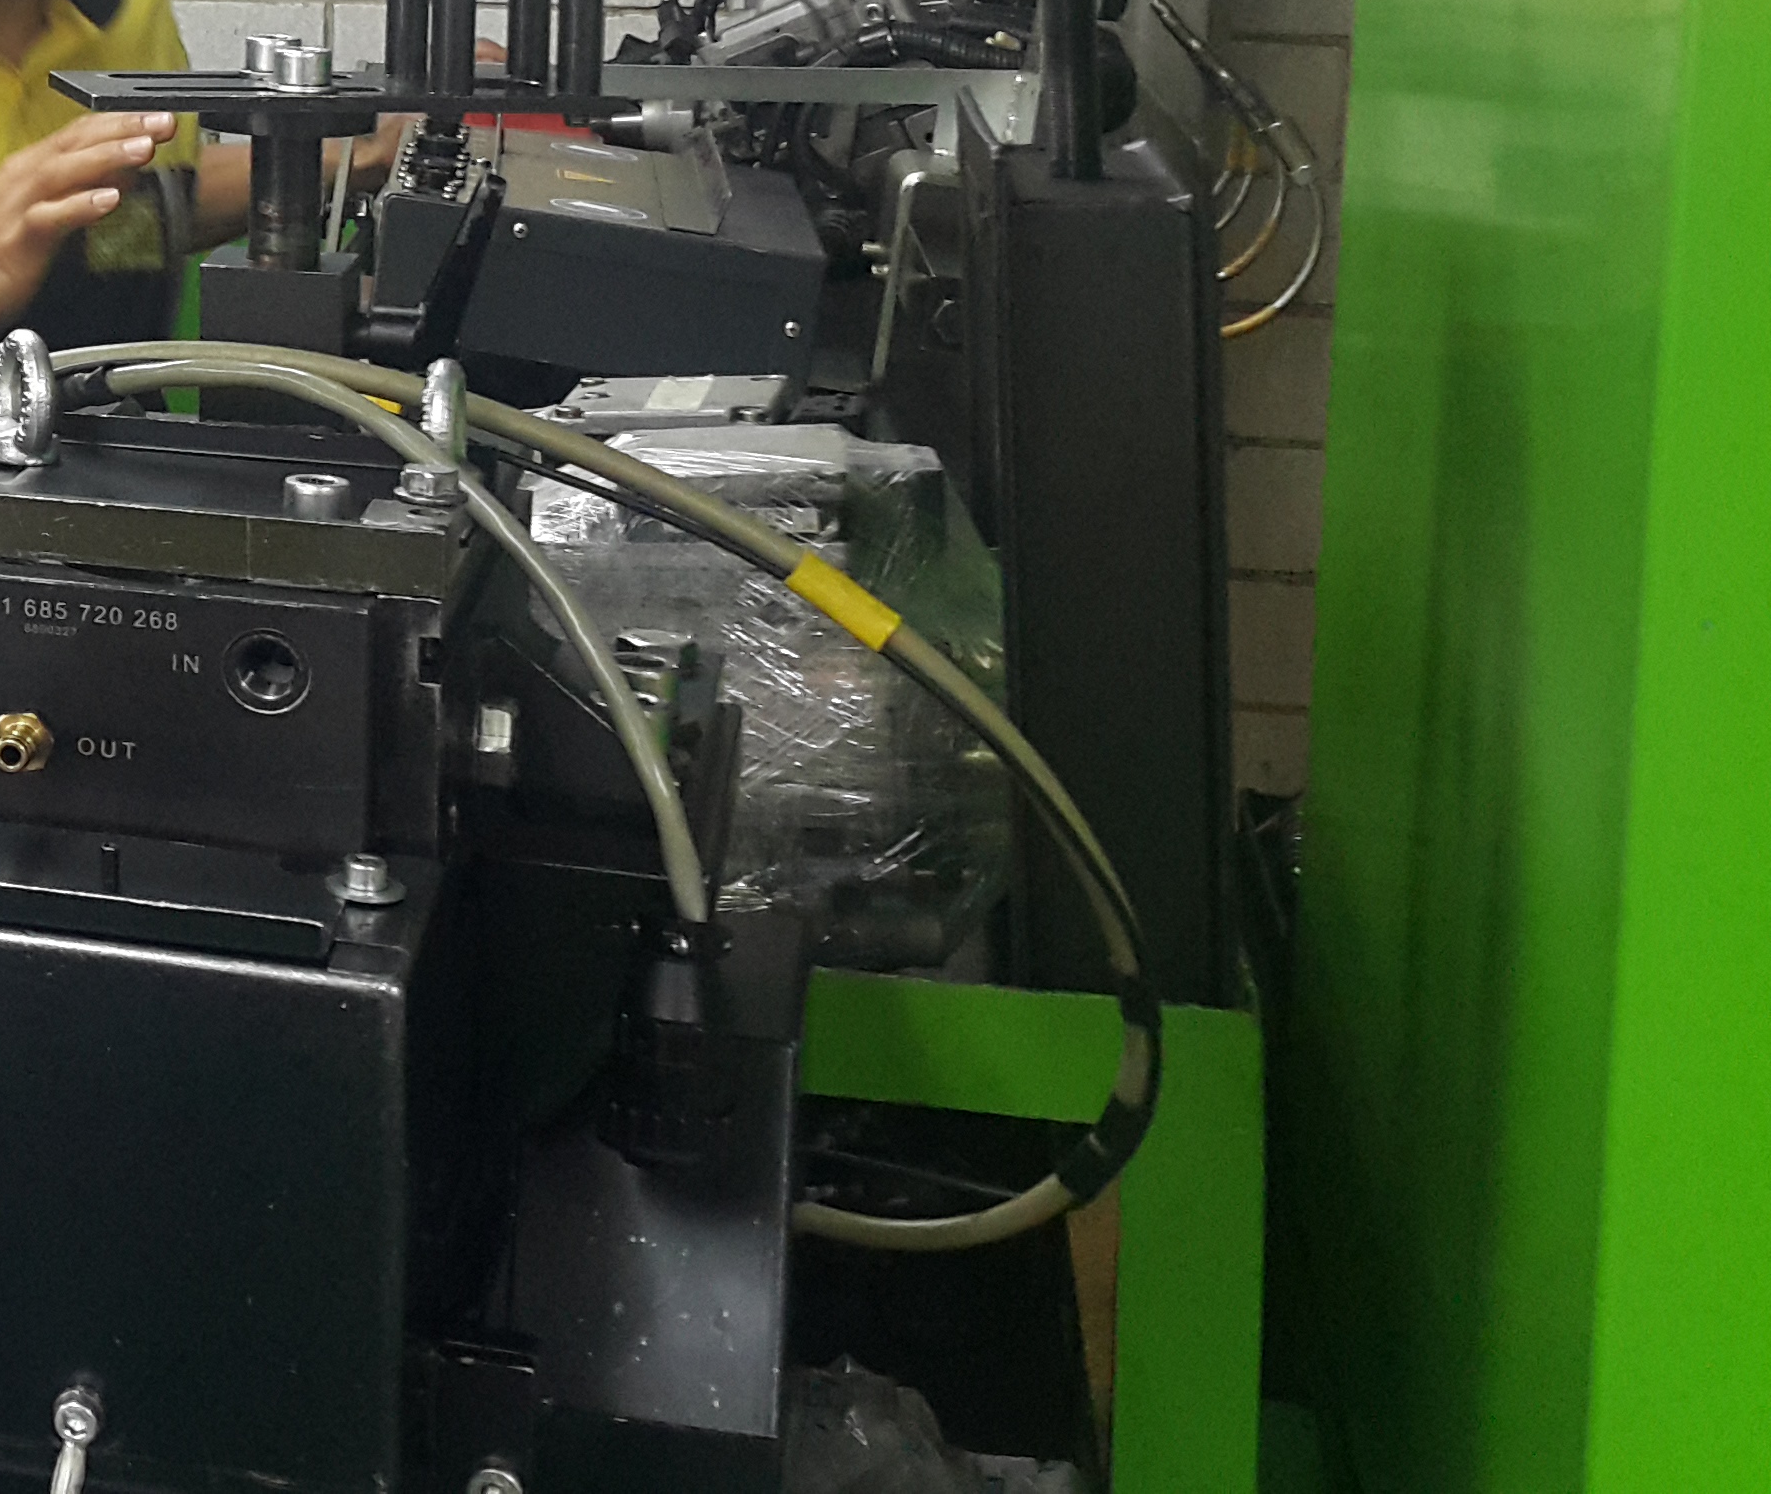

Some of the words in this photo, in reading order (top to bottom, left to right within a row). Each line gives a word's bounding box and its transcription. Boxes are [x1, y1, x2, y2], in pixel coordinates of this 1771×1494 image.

[1, 596, 11, 615] 1
[23, 597, 68, 620] 685
[79, 603, 124, 625] 720
[132, 608, 178, 631] 268
[171, 652, 200, 674] IN
[77, 736, 136, 760] OUT
